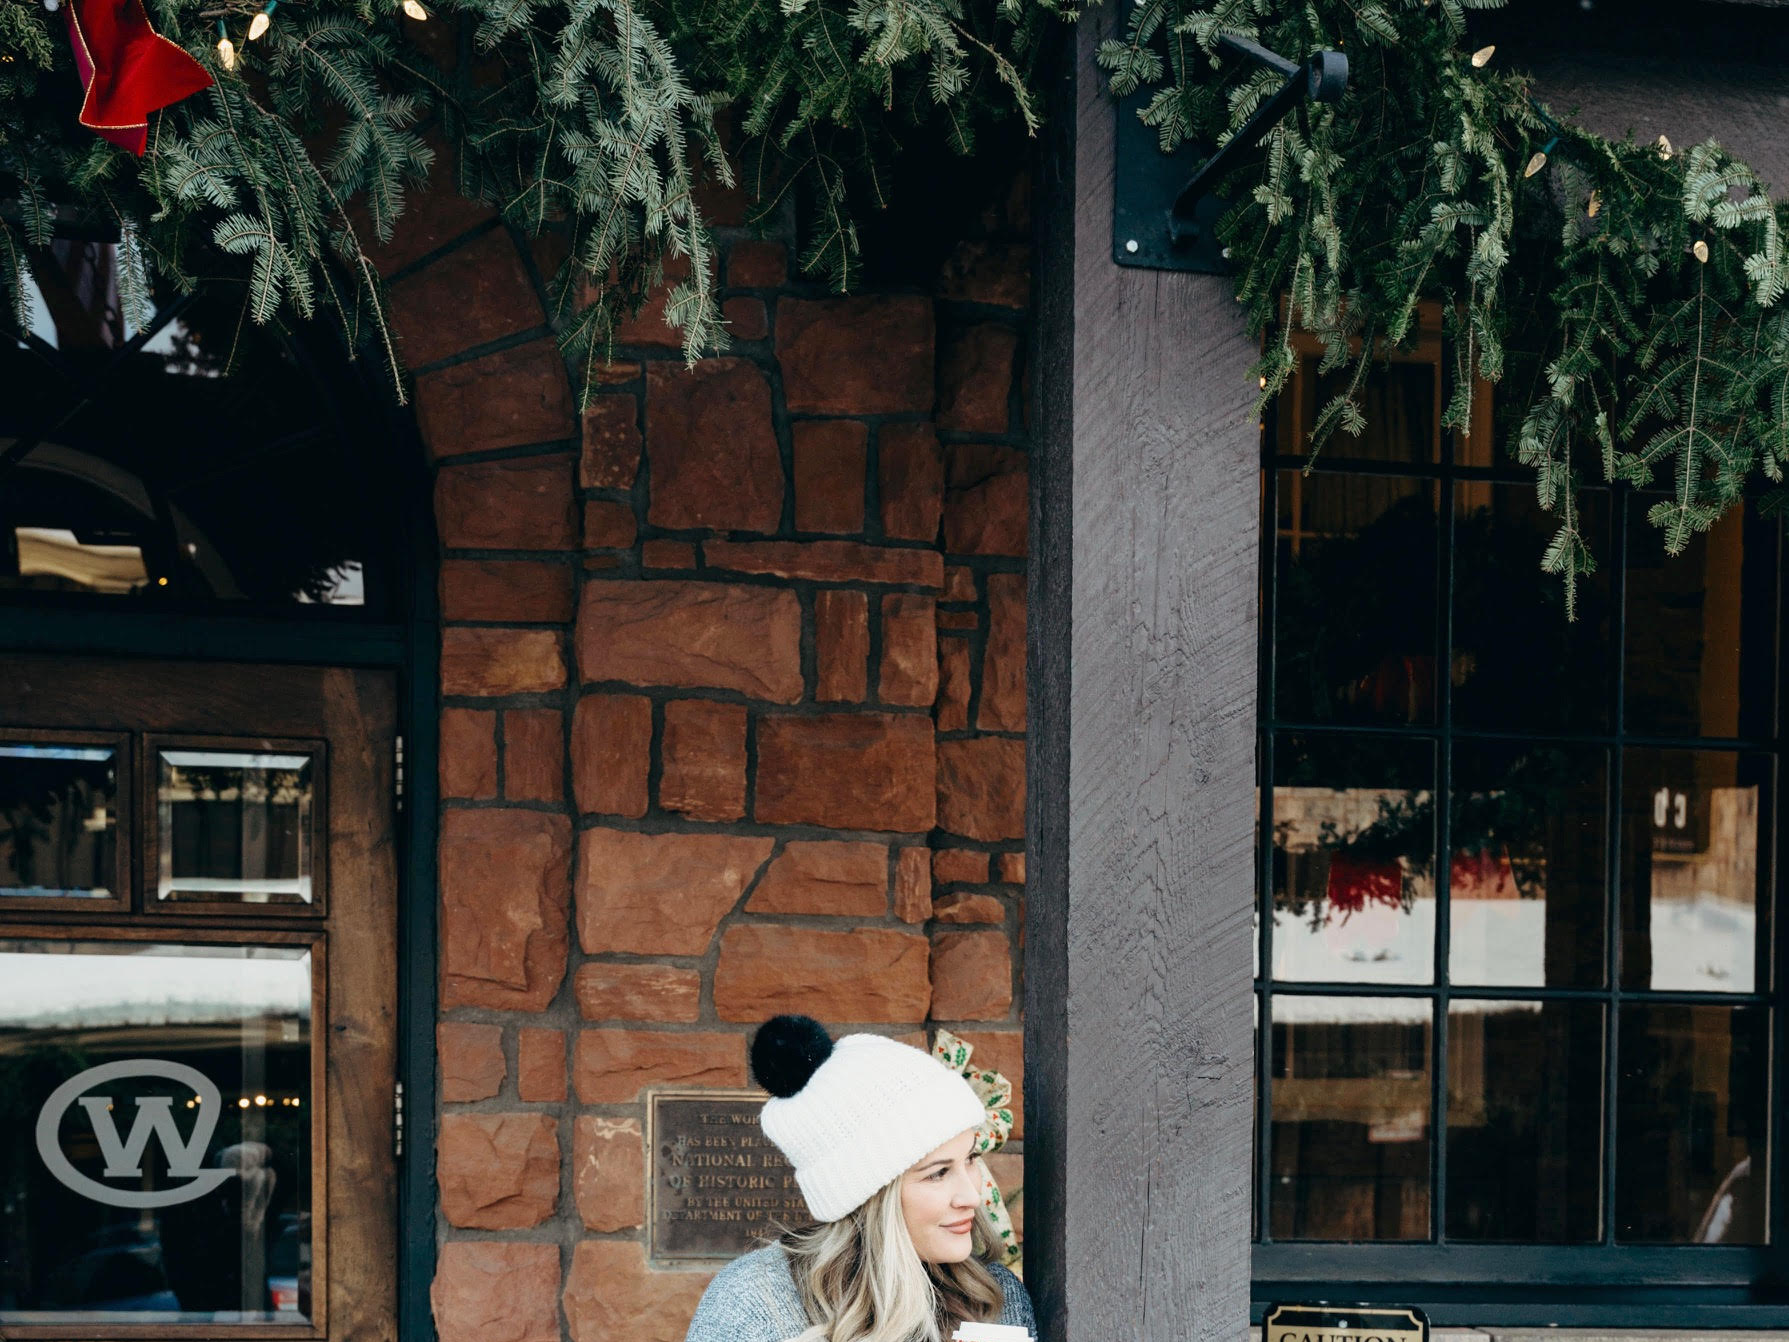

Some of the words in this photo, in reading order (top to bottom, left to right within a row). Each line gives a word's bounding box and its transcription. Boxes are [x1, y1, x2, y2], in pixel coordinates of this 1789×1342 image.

[700, 1113, 727, 1125] TE
[731, 1113, 761, 1125] WOR
[677, 1135, 701, 1147] HAS
[705, 1135, 738, 1148] BEEN
[672, 1153, 756, 1167] NATIONAL
[669, 1174, 691, 1188] OF
[699, 1175, 776, 1189] HISTORIC
[688, 1197, 703, 1207] BY
[706, 1197, 730, 1208] THE
[735, 1197, 779, 1208] UNITED
[662, 1209, 742, 1221] DARTMENT
[747, 1210, 762, 1221] OF
